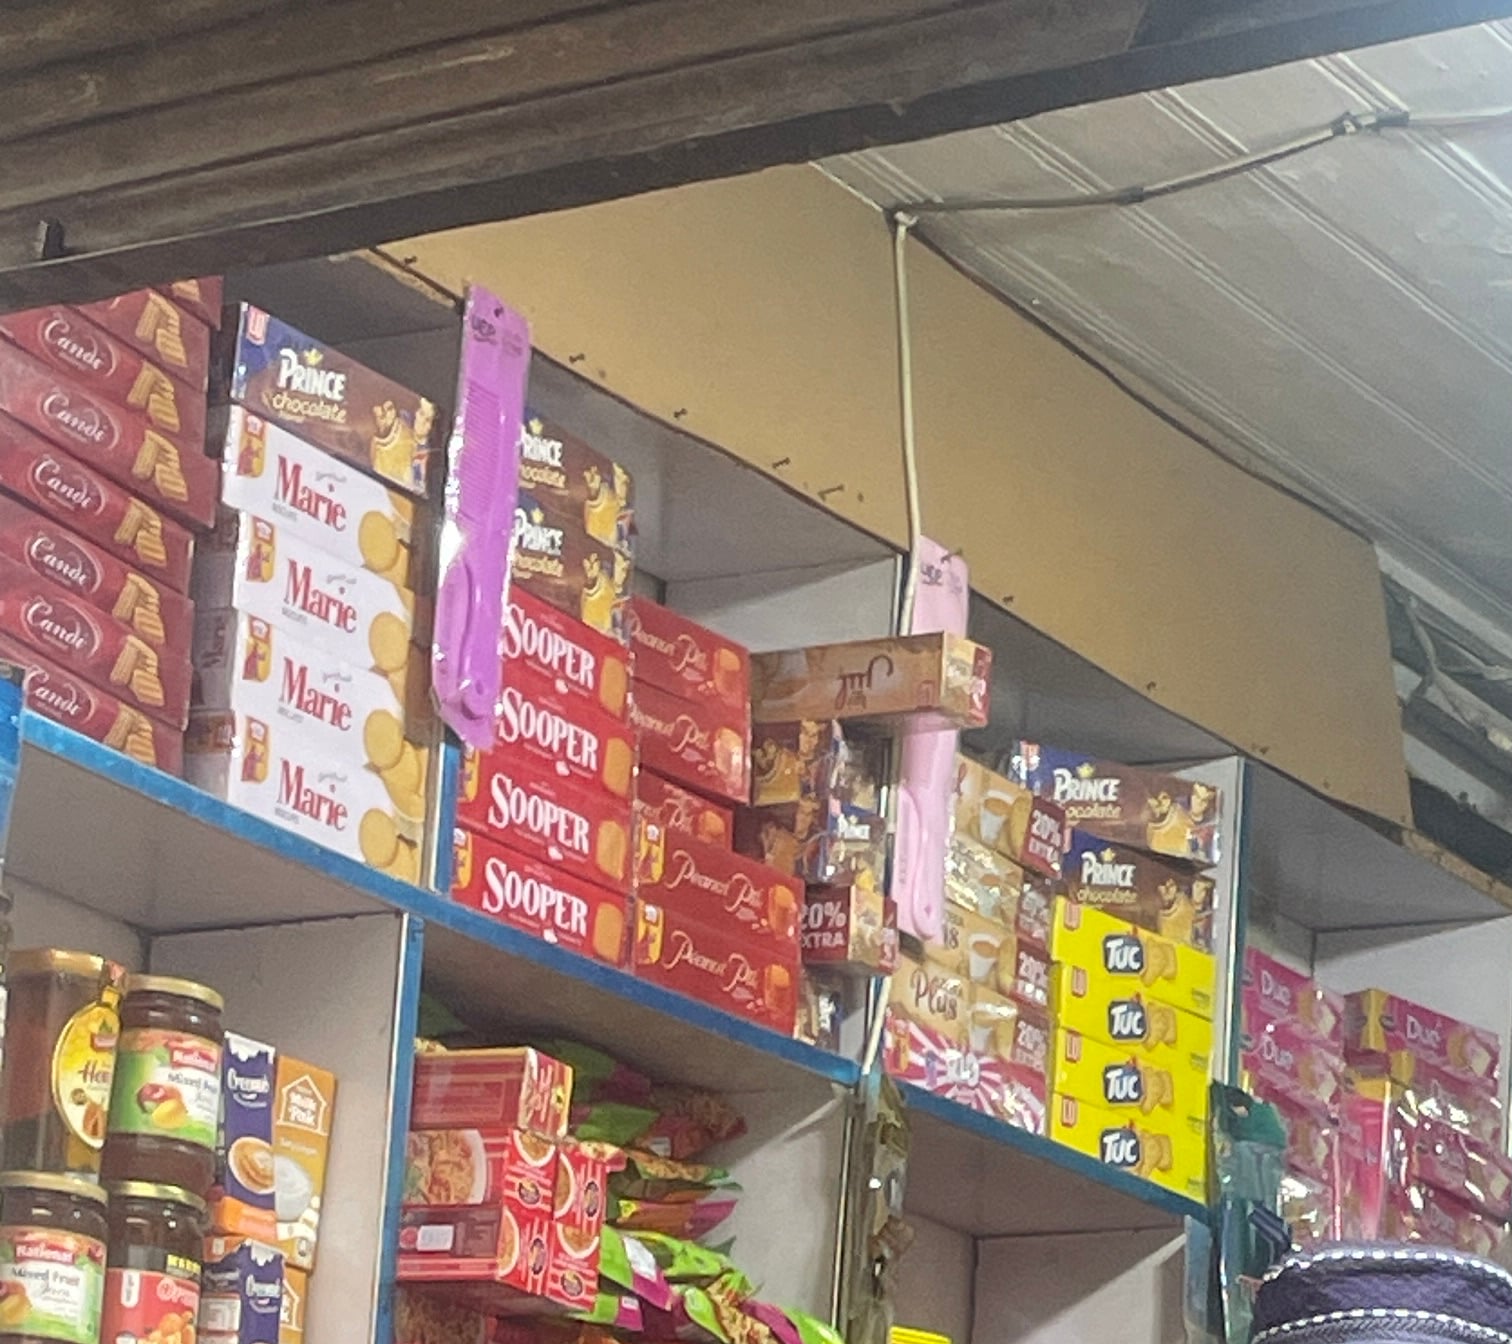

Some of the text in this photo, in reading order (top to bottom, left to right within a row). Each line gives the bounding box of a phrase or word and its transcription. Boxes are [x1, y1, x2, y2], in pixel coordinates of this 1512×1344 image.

[279, 349, 346, 400] PRINCE
[272, 391, 347, 423] chocolate
[277, 453, 346, 532] Marie
[512, 508, 564, 556] PRINCE
[287, 561, 357, 633] Marie
[503, 604, 595, 690] SOOPER
[283, 658, 352, 731] Marie
[500, 687, 598, 772] SOOPER
[279, 759, 348, 832] Marie
[1053, 767, 1121, 801] PRINCE
[488, 773, 590, 855] SOOPER
[1065, 802, 1122, 820] ocolate
[1081, 850, 1137, 887] PRINCE
[482, 857, 588, 936] SOOPER
[800, 930, 847, 949] XTRA
[1106, 939, 1142, 970] TUC
[1110, 1005, 1145, 1036] TUC
[1107, 1070, 1141, 1102] TUC
[1103, 1134, 1139, 1163] TUC
[16, 1244, 74, 1264] National
